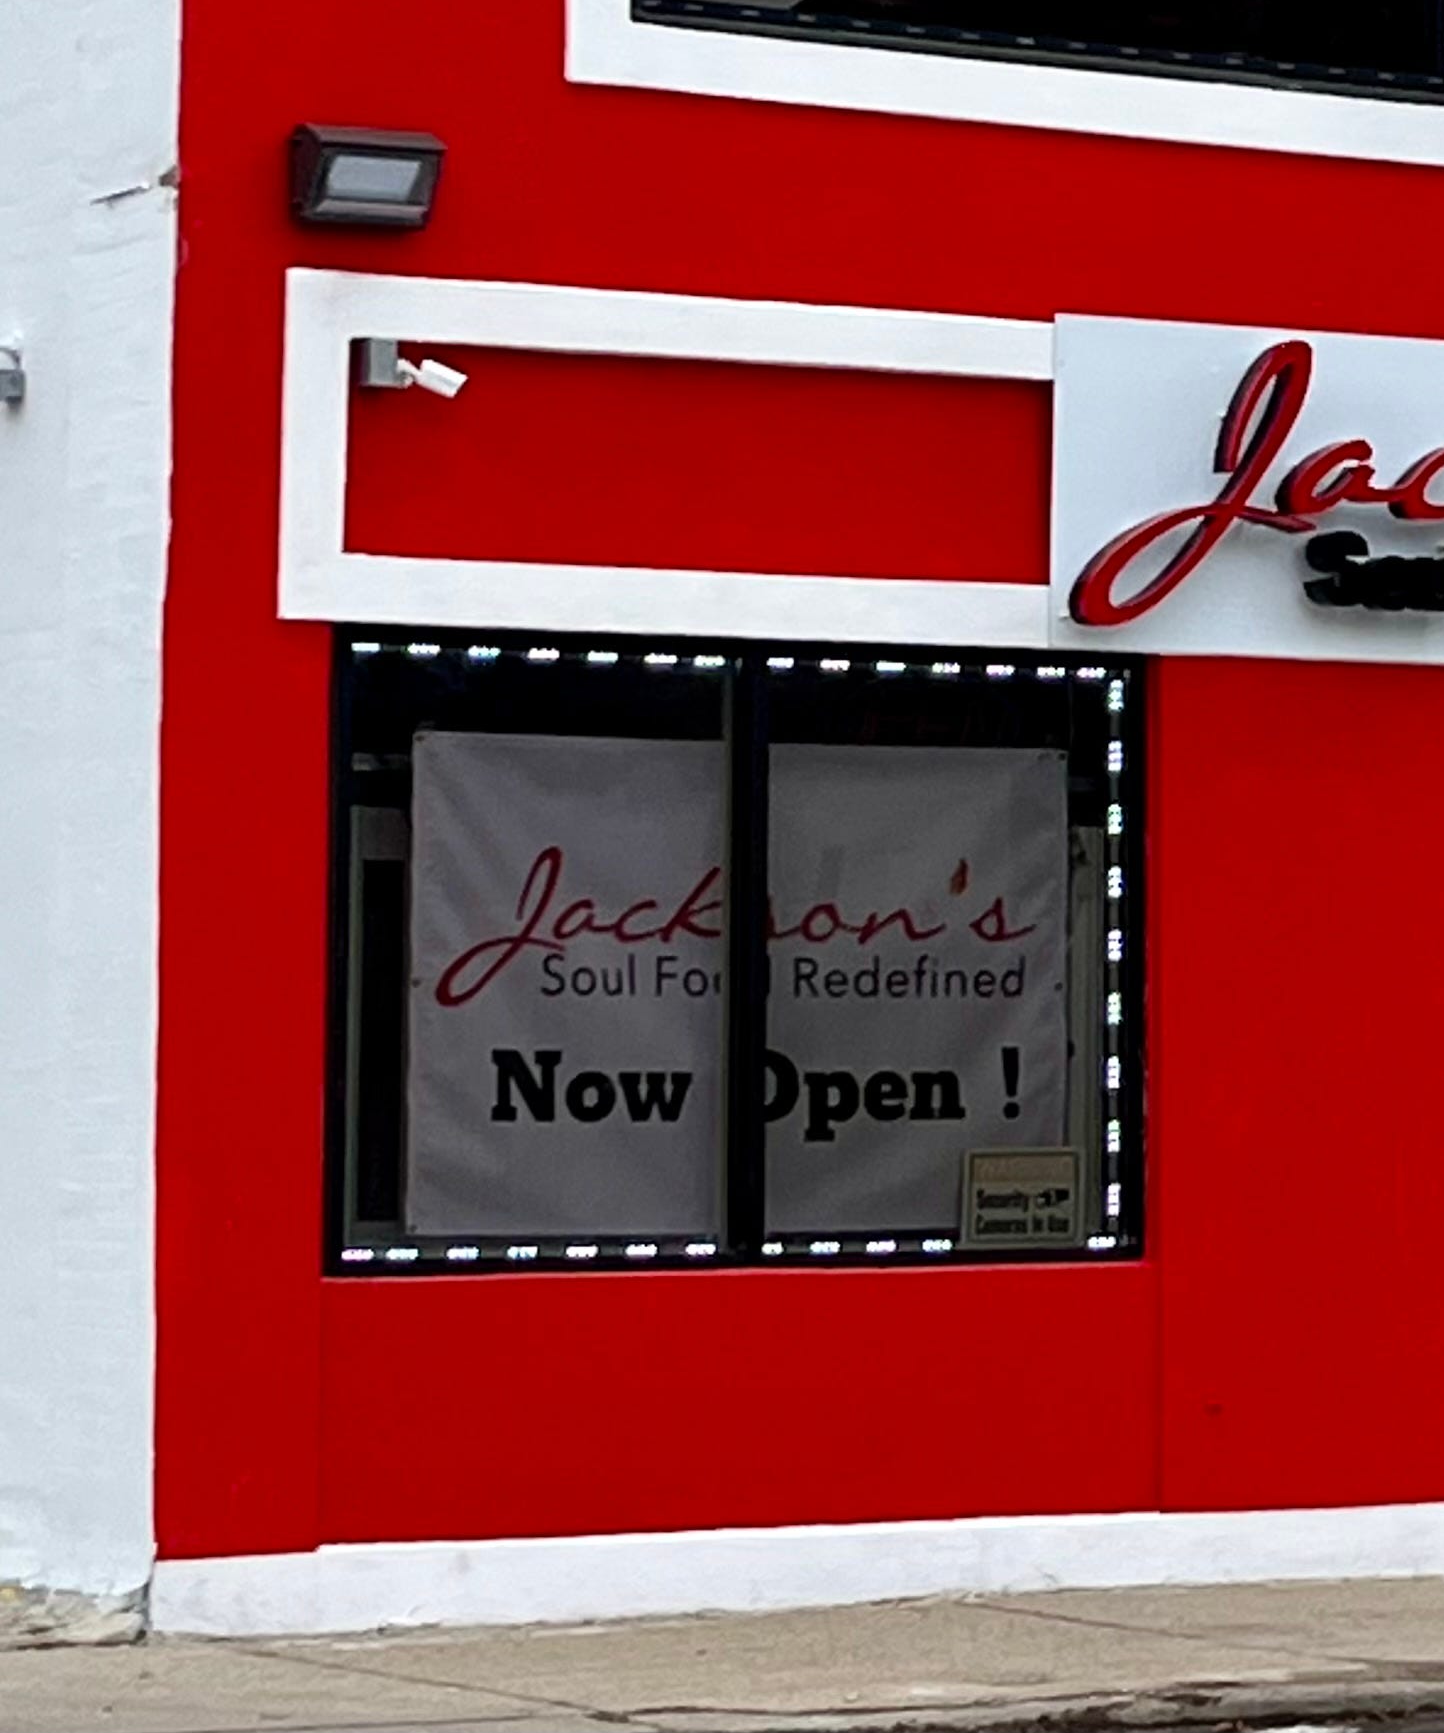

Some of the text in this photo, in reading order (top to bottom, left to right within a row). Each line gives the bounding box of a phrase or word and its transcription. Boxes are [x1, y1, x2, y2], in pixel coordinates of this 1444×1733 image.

[435, 845, 1036, 1007] Jackon's
[540, 953, 637, 997] Soul
[793, 954, 1026, 998] Redefined
[490, 1048, 693, 1122] Now
